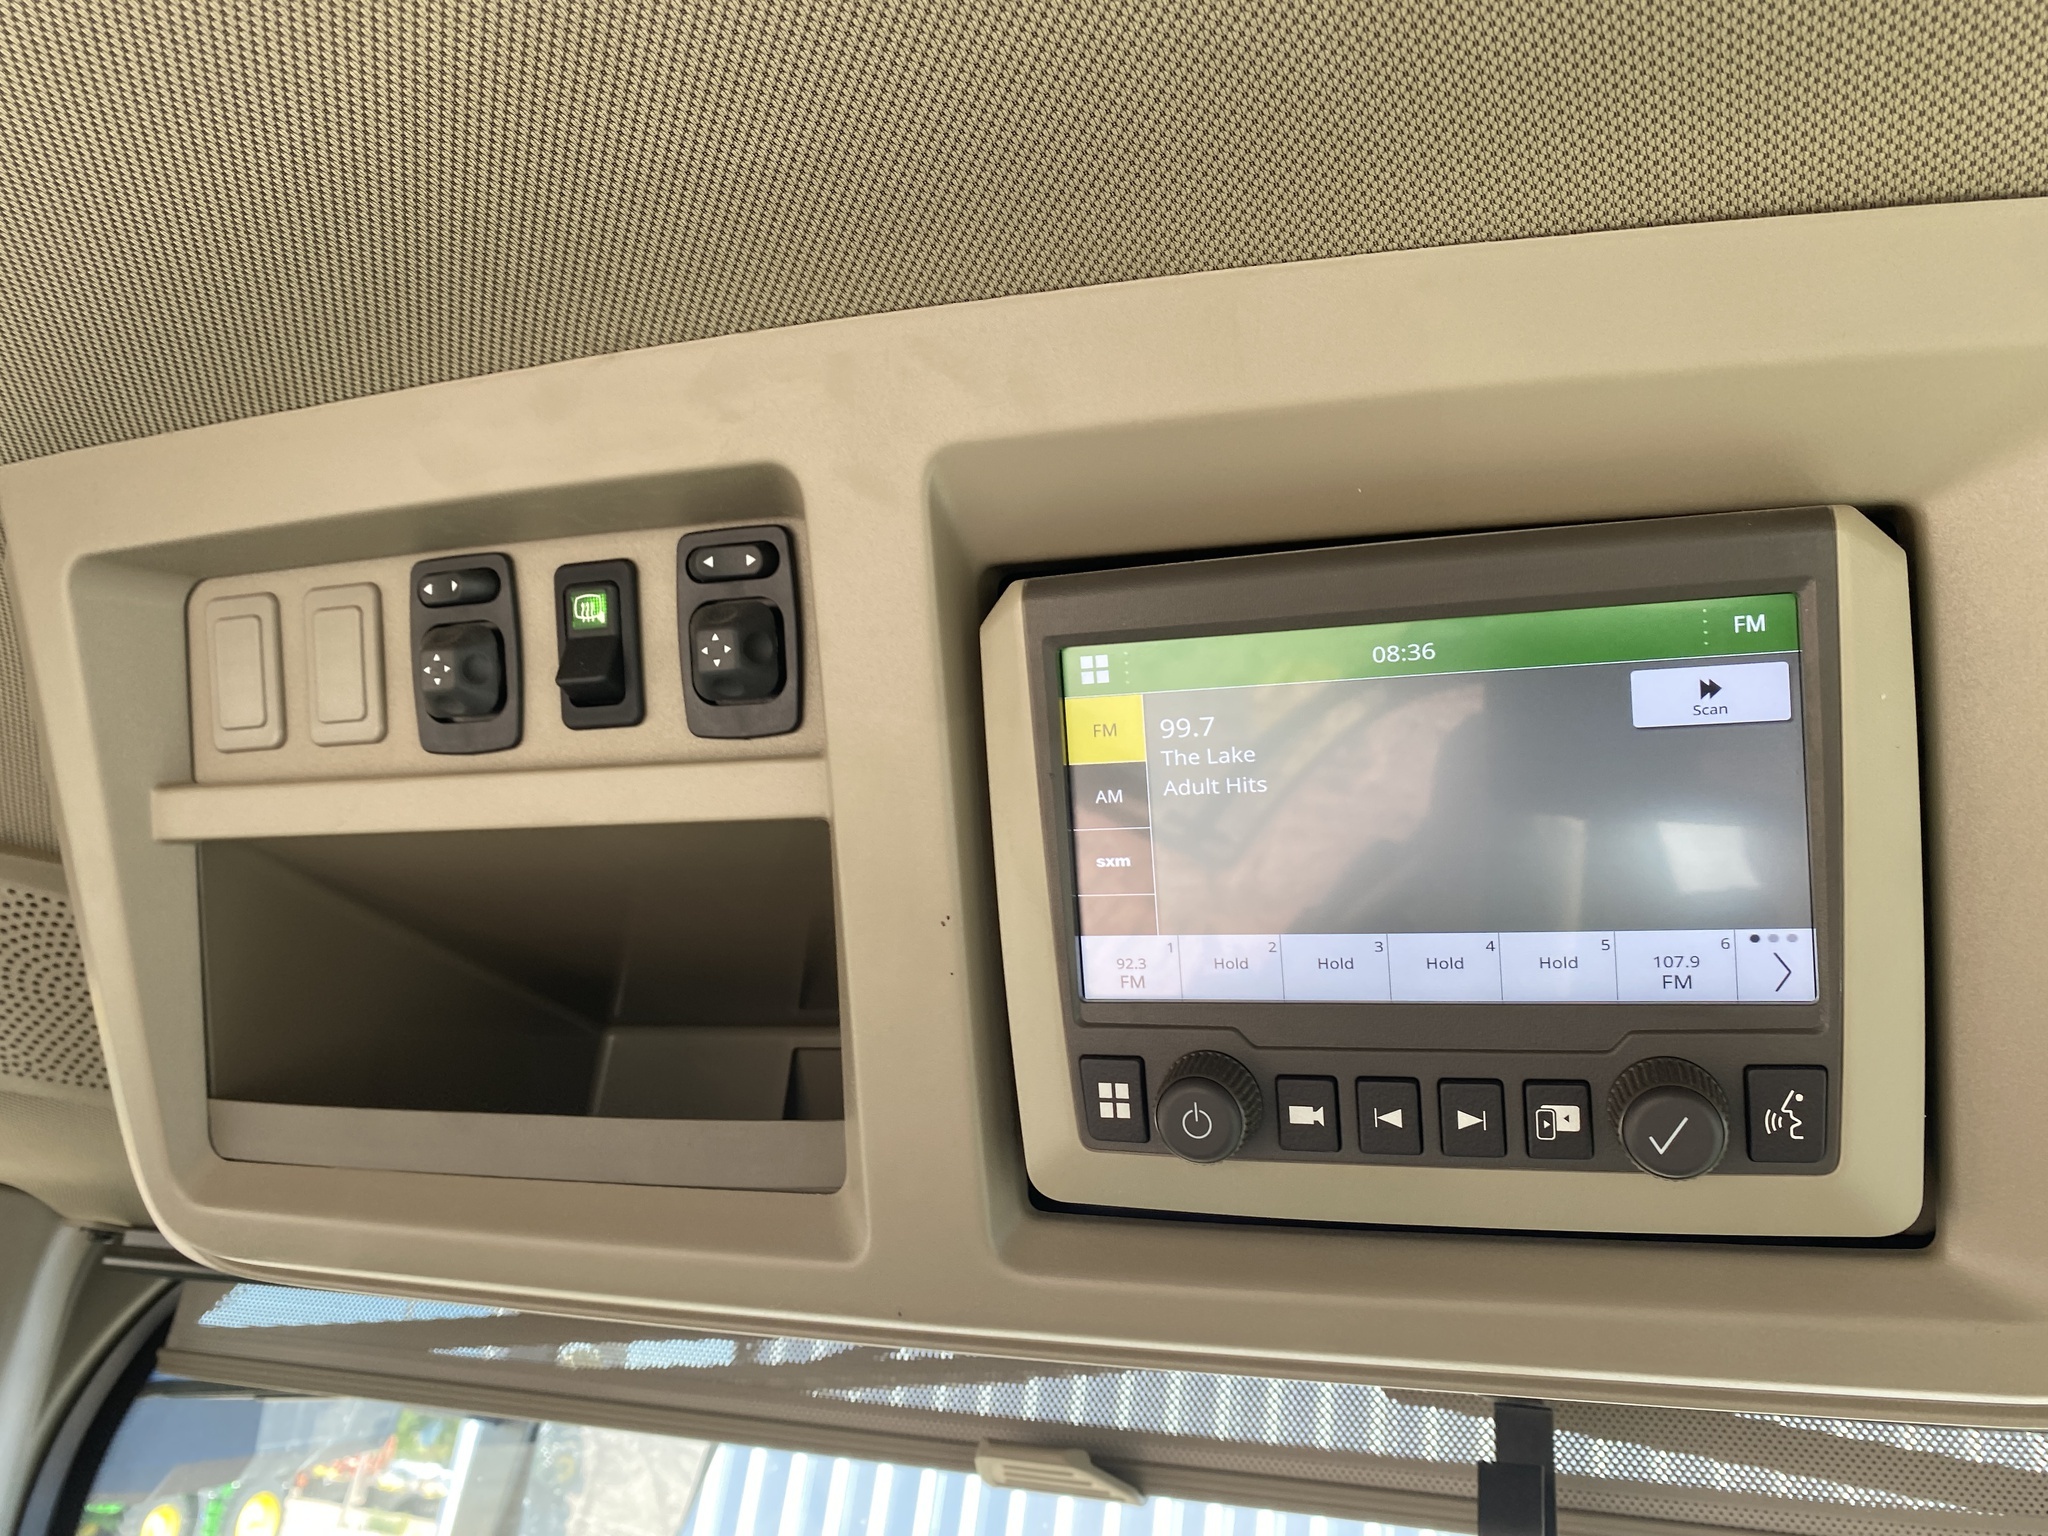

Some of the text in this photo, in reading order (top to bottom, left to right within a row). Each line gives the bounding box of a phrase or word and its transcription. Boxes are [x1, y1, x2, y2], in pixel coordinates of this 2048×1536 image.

[1733, 613, 1766, 634] FM
[1371, 642, 1437, 664] 08:36
[1692, 702, 1729, 717] Scan
[1092, 723, 1118, 738] FM
[1159, 716, 1215, 739] 99.7
[1160, 746, 1257, 767] The Lake
[1163, 776, 1268, 797] Adult Hits
[1095, 789, 1124, 804] AM
[1095, 855, 1132, 868] sxm
[1166, 942, 1173, 953] 1
[1268, 941, 1277, 953] 2
[1374, 940, 1384, 953] 3
[1485, 940, 1496, 952] 4
[1601, 939, 1611, 951] 5
[1720, 937, 1731, 950] 6
[1115, 957, 1147, 970] 92.3
[1213, 956, 1249, 970] Hold
[1317, 957, 1355, 970] Hold
[1426, 956, 1465, 970] Hold
[1539, 956, 1579, 970] Hold
[1653, 954, 1701, 968] 107.9
[1119, 975, 1146, 989] FM
[1662, 974, 1693, 990] FM
